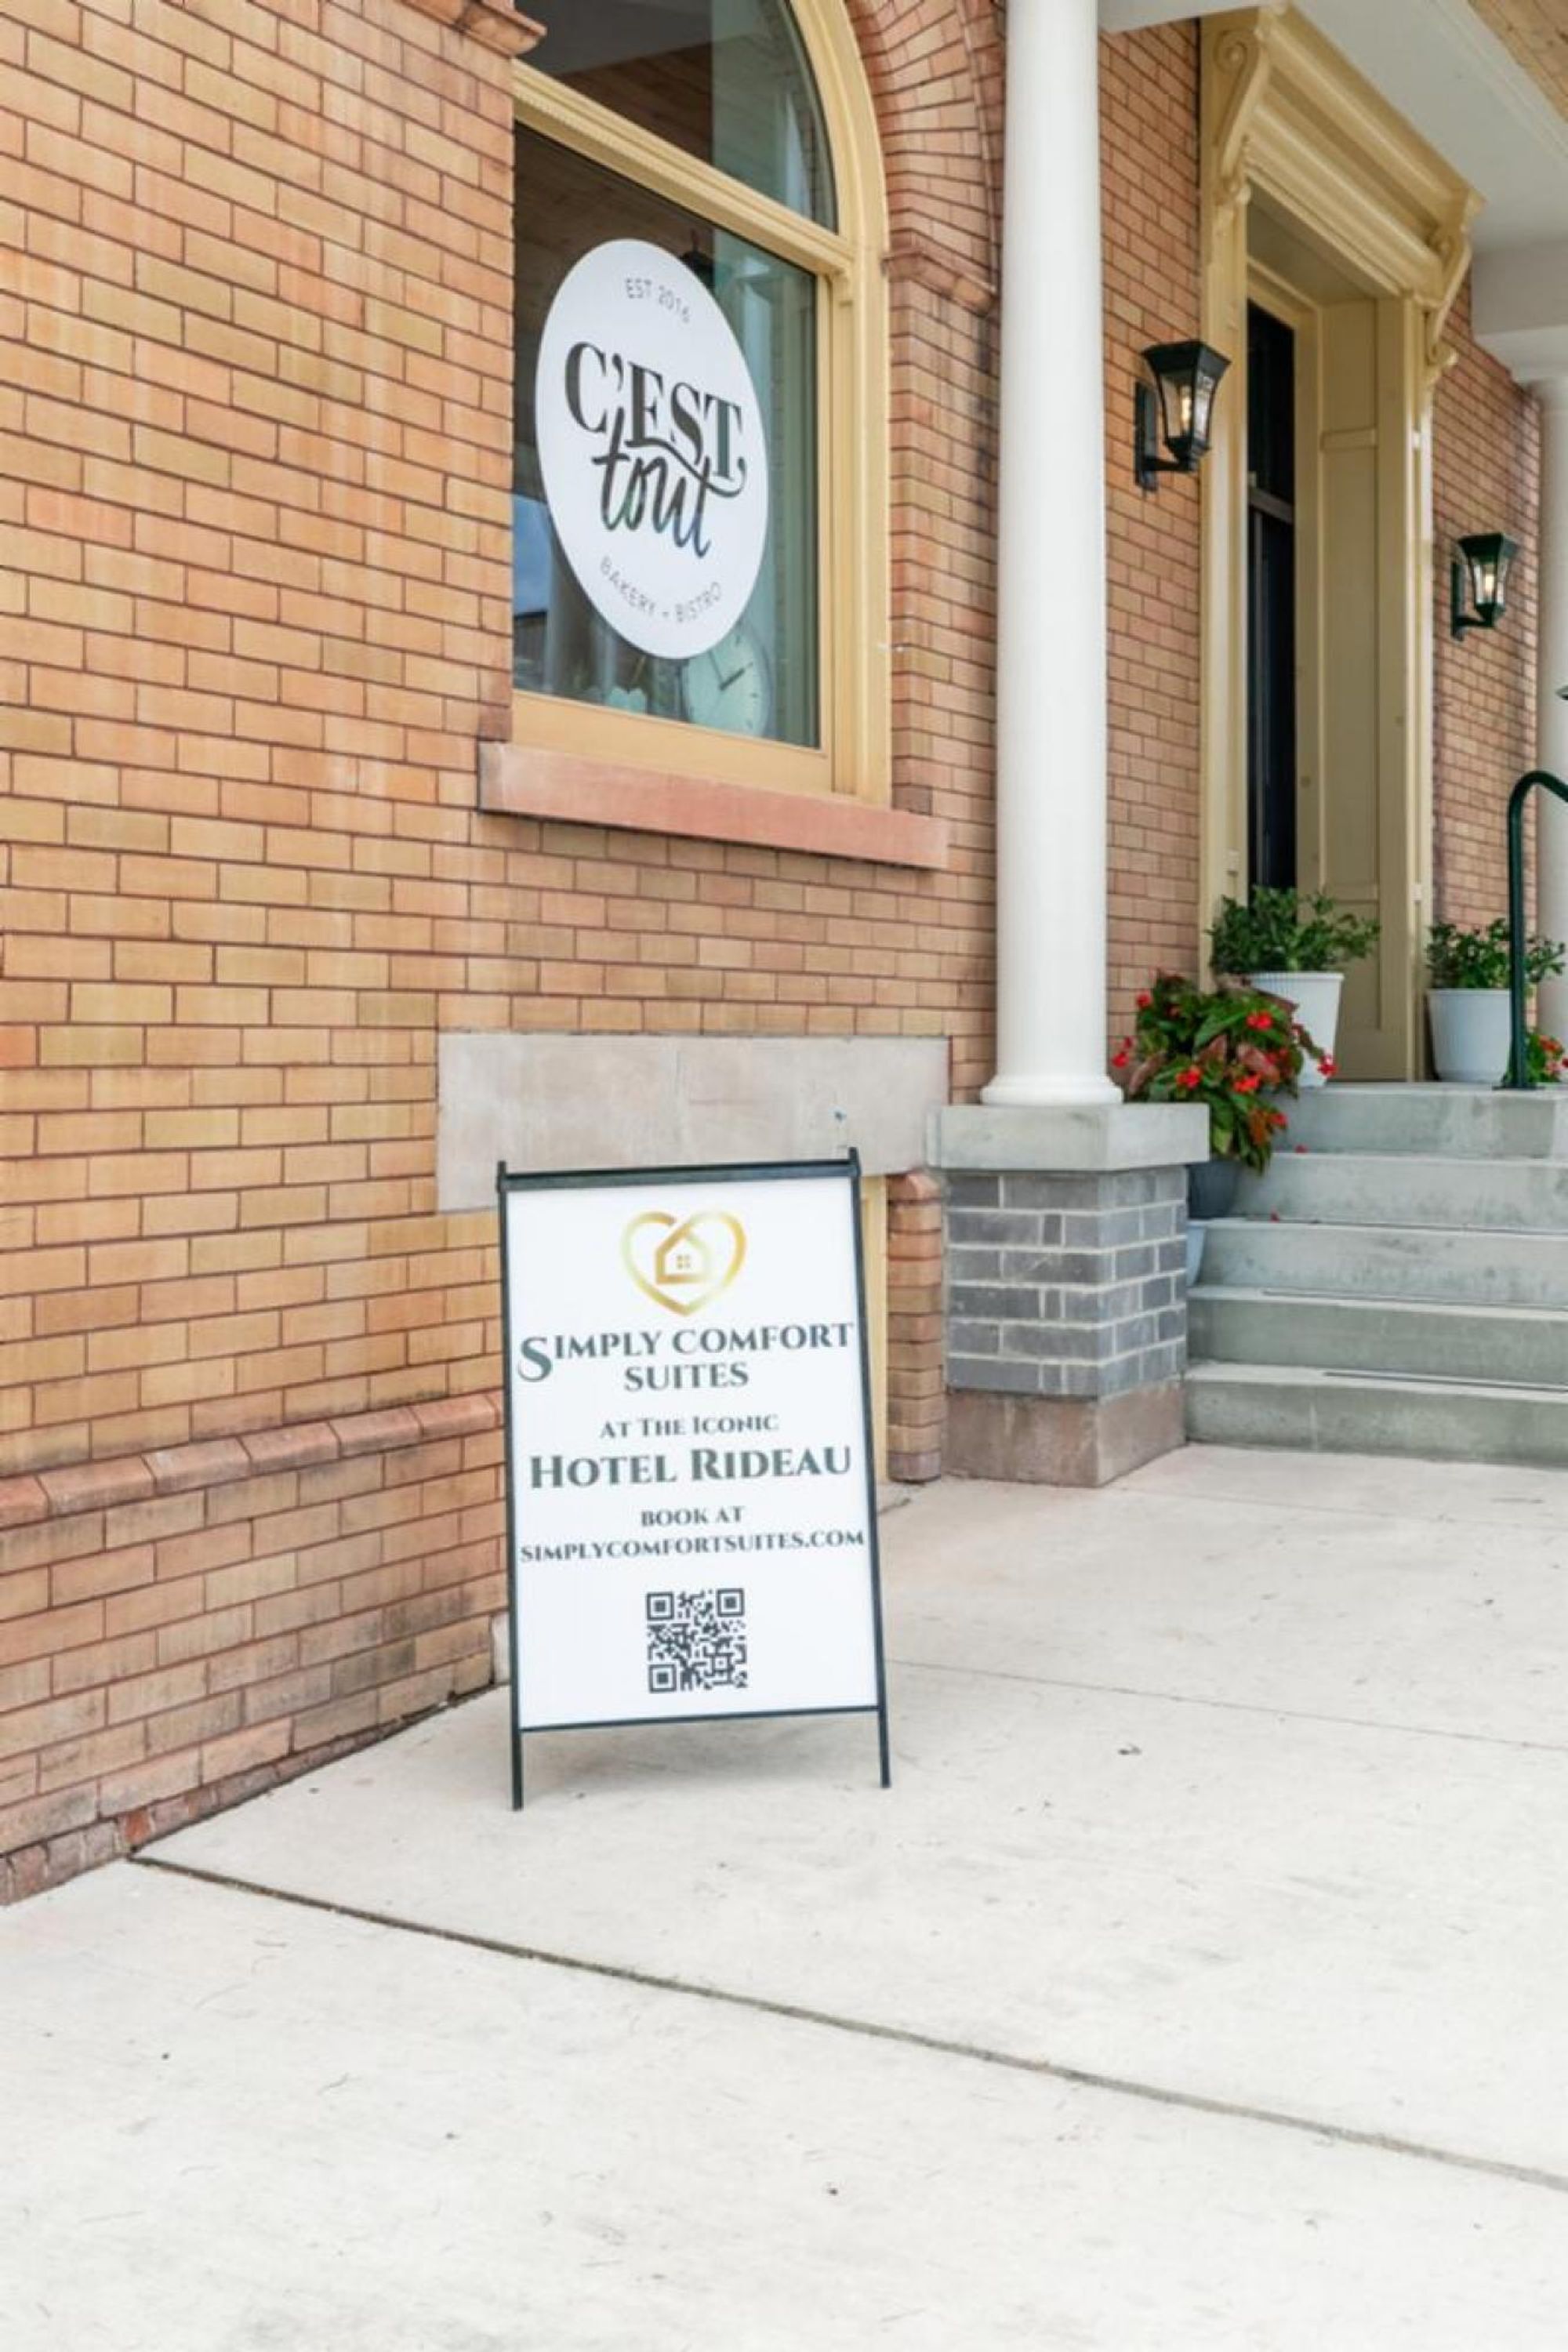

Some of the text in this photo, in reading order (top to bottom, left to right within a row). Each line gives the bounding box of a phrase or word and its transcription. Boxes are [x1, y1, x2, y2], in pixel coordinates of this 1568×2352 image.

[625, 278, 652, 299] EST
[564, 342, 745, 496] C'EST
[591, 407, 711, 557] tout
[601, 556, 655, 616] BAKERY
[675, 582, 722, 623] BISTRO
[518, 1322, 853, 1382] SIMPLY COMFORT
[624, 1363, 749, 1392] SUITES
[600, 1421, 632, 1439] AT
[529, 1446, 851, 1489] HOTEL RIDEAU
[641, 1506, 745, 1528] BOOK AT
[520, 1530, 866, 1563] SIMPLYCOMFORTSUITES.COM
